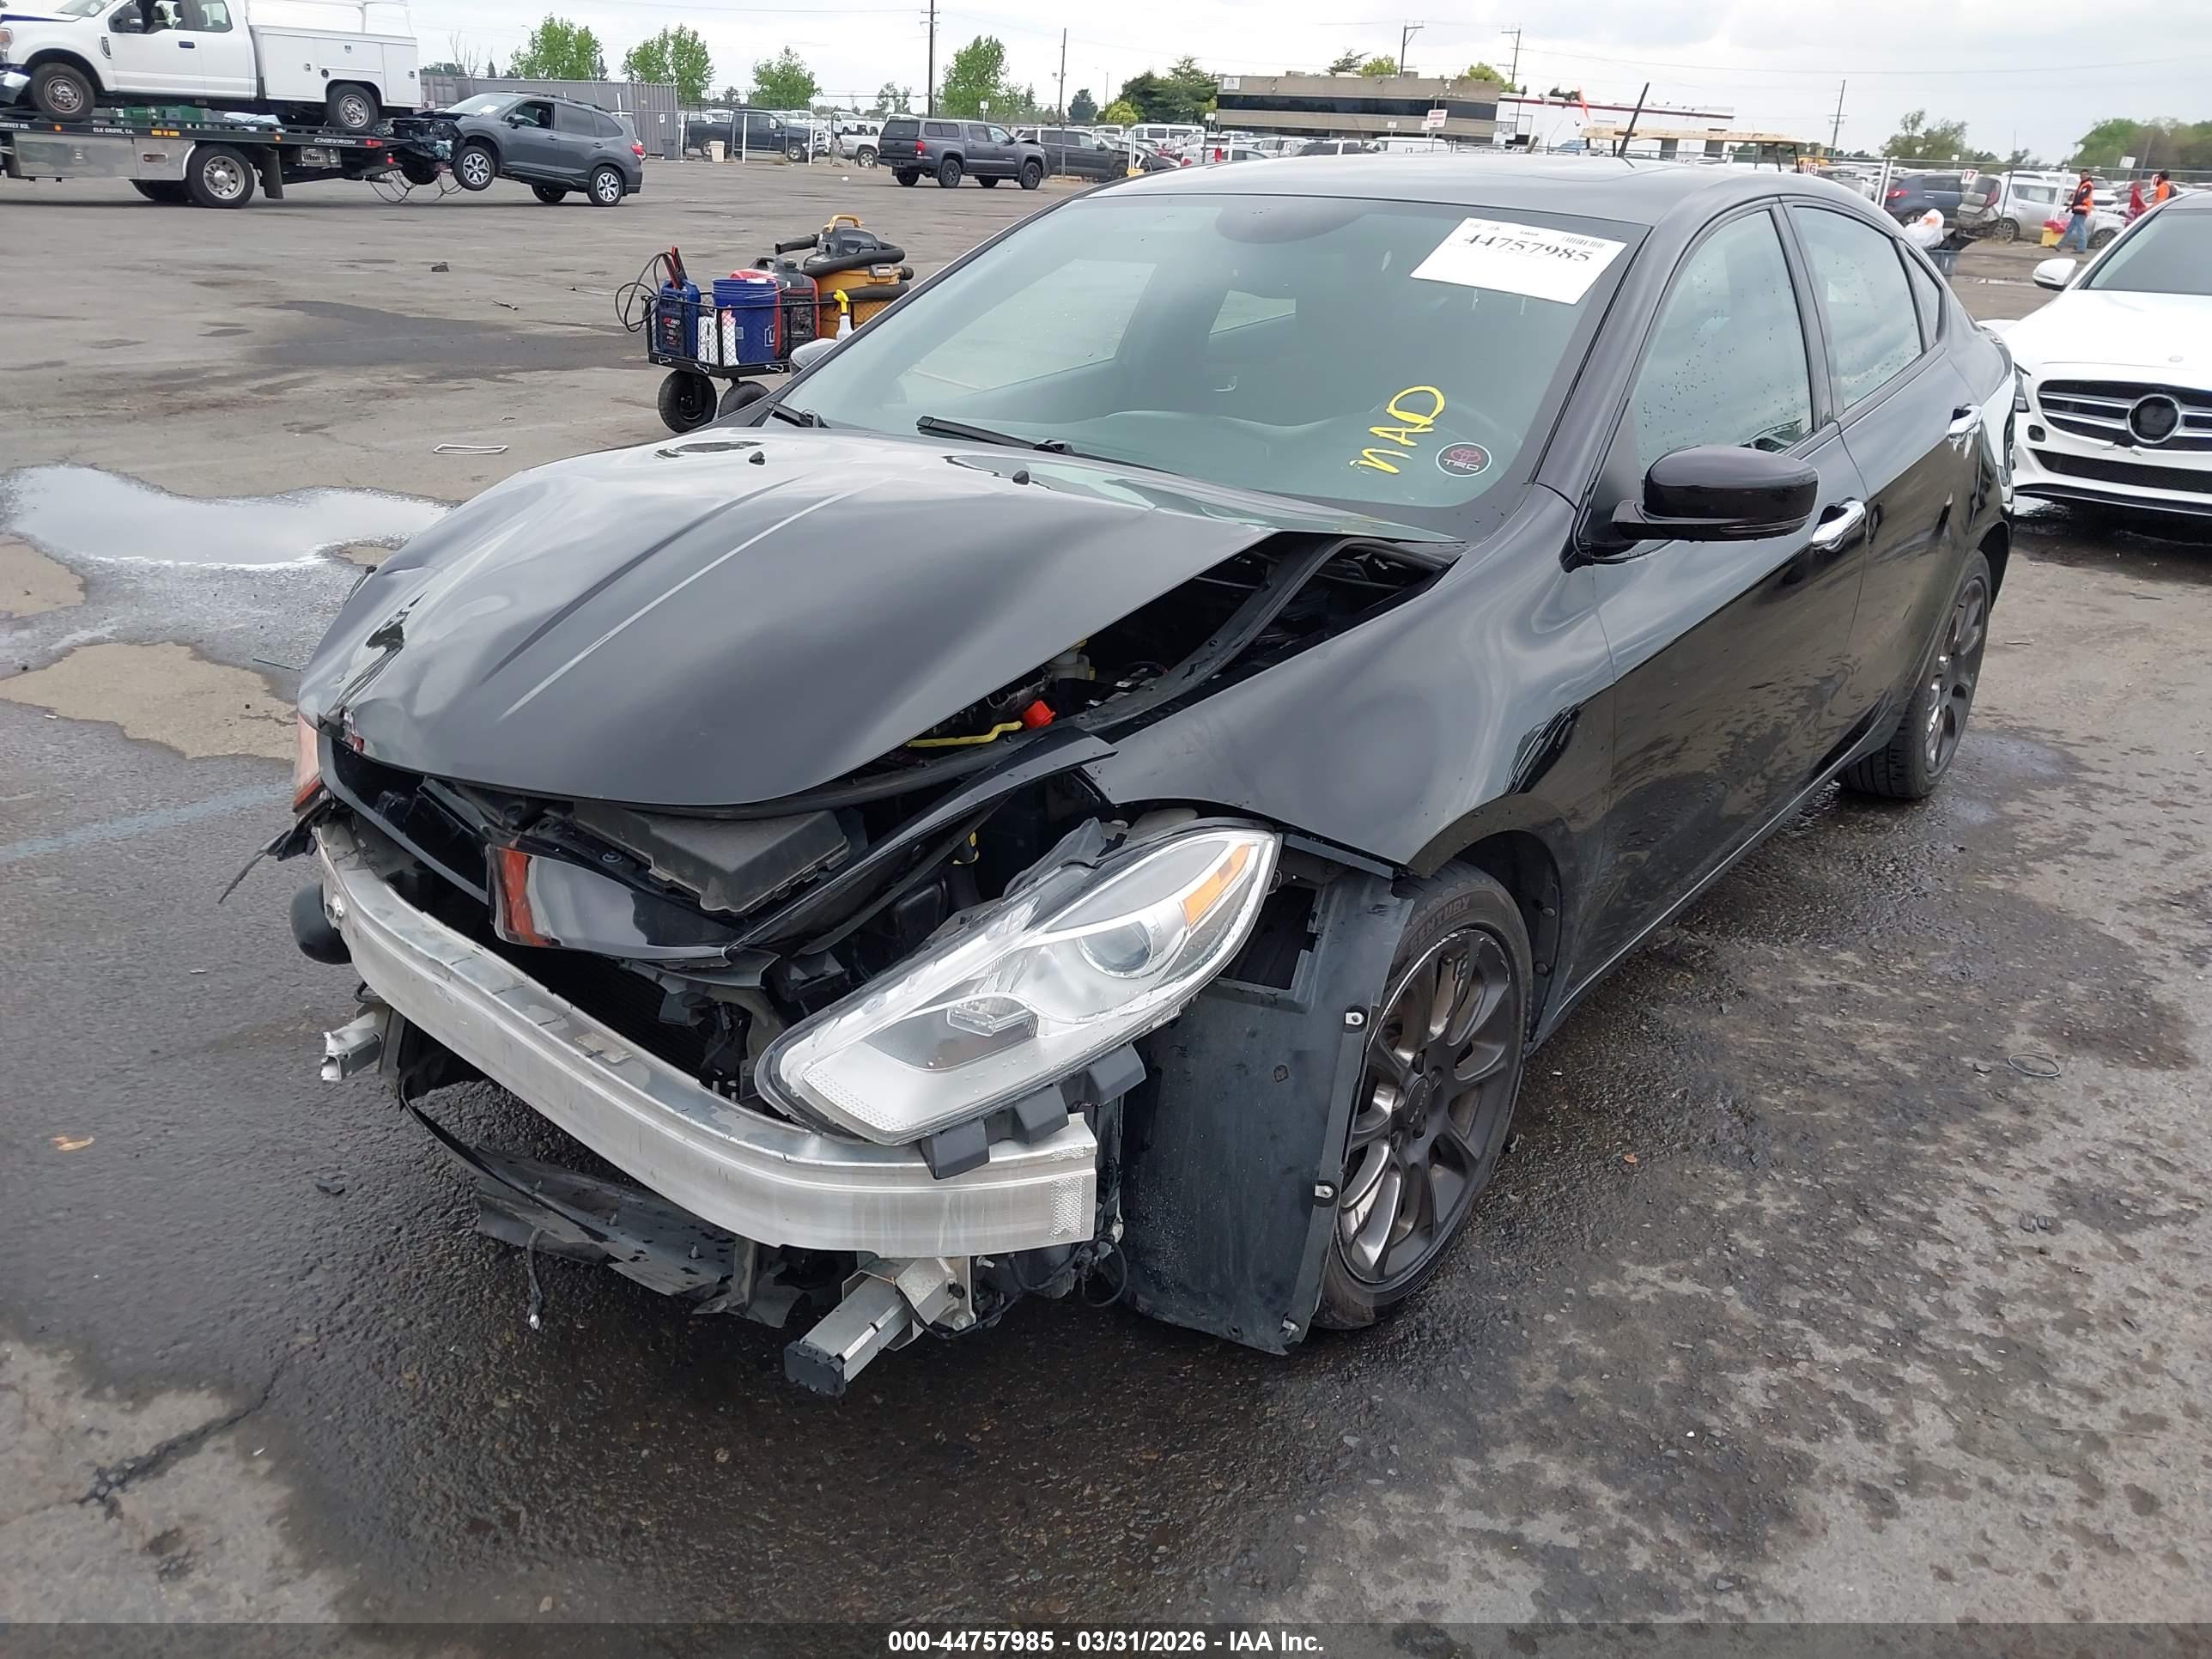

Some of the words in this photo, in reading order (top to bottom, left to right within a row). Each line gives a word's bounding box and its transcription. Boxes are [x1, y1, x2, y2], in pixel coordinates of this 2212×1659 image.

[1805, 164, 1815, 173] 16
[1964, 170, 1977, 180] 17
[1463, 233, 1594, 262] 44757985
[1443, 459, 1480, 471] TRD
